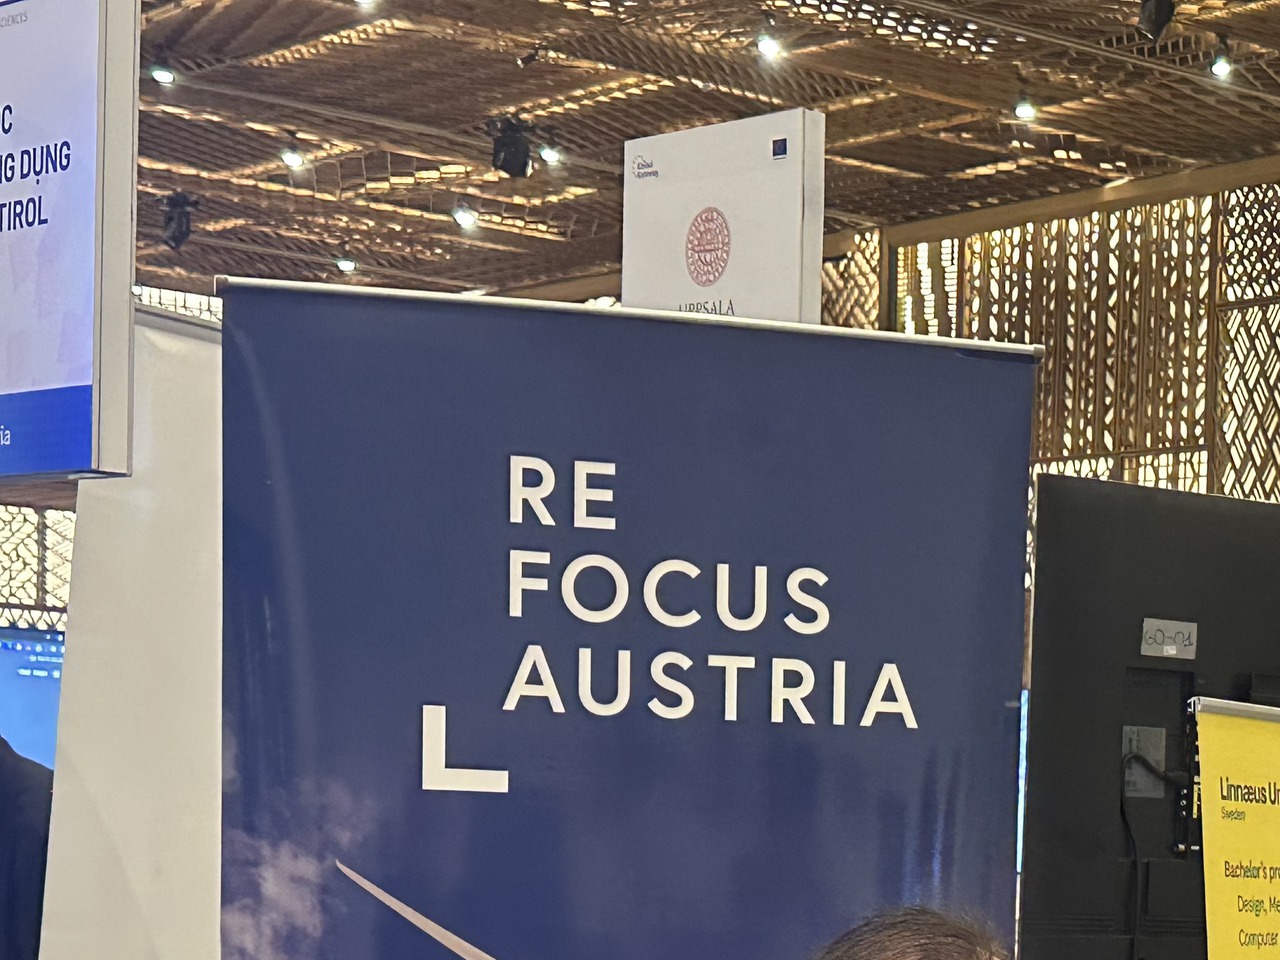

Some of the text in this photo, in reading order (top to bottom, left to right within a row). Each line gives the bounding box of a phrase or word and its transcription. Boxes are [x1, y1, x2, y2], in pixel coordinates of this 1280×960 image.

[20, 141, 71, 185] DỤNG
[509, 455, 616, 530] RE
[508, 549, 830, 635] FOCUS
[502, 644, 918, 729] AUSTRIA
[1220, 776, 1267, 804] Linnæus
[1237, 895, 1267, 917] Design,
[1239, 929, 1278, 949] Computer
